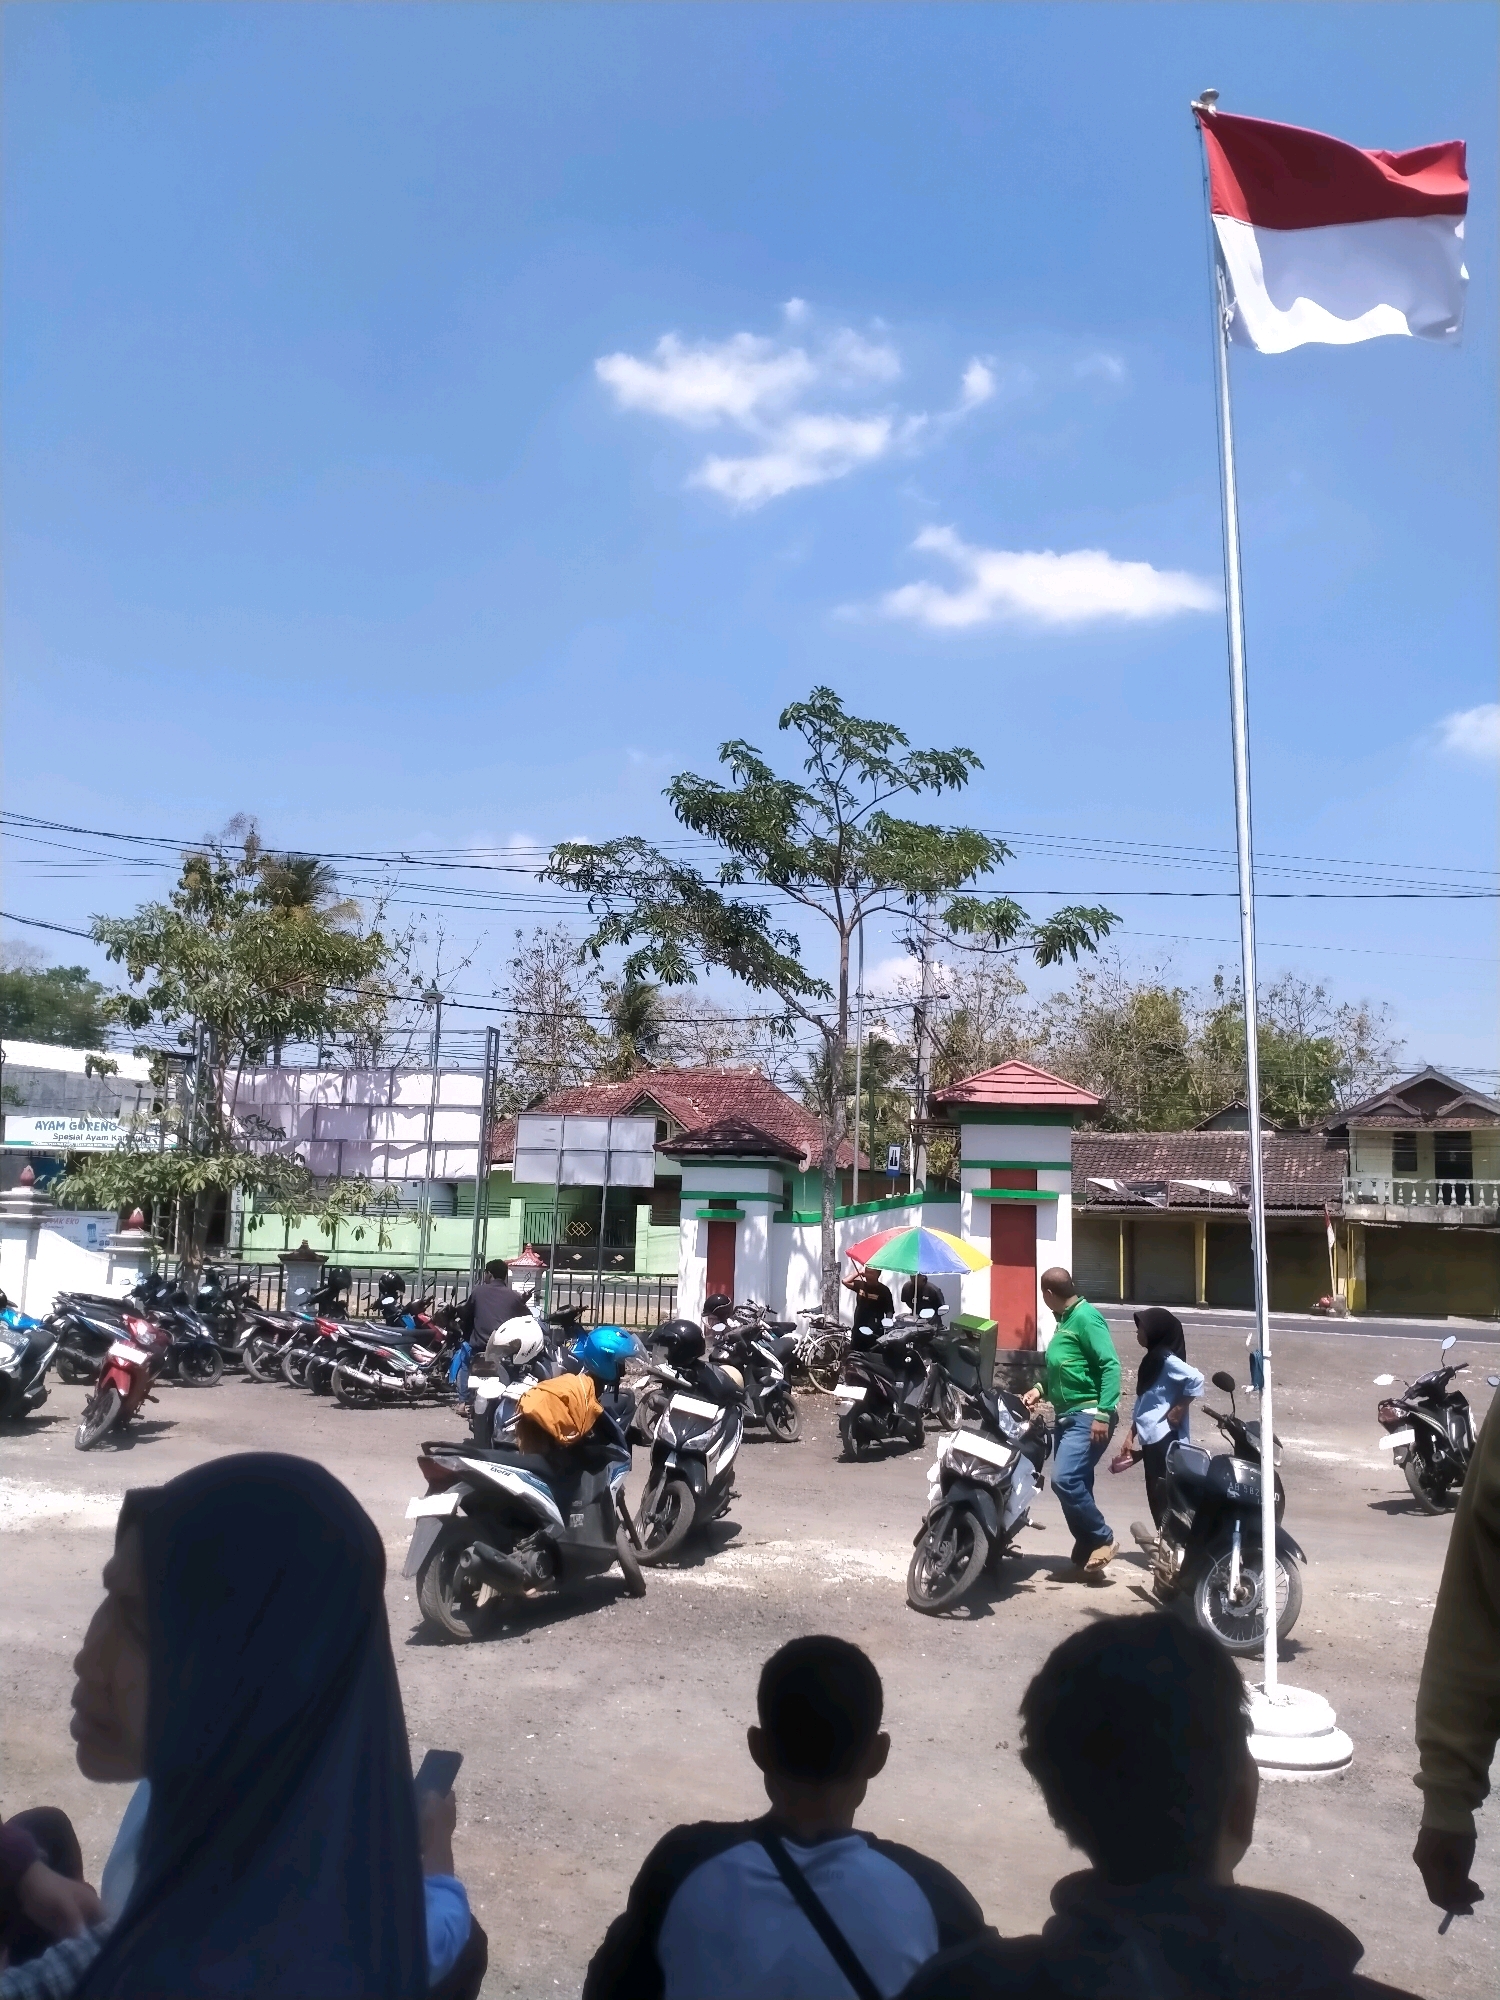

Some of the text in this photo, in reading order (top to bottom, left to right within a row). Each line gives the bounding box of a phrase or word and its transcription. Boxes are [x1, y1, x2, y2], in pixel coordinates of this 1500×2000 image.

[34, 1120, 118, 1132] AYAM GORENG
[53, 1132, 83, 1141] Spesial
[86, 1133, 109, 1142] Ayam
[1228, 1482, 1240, 1491] AB
[1243, 1485, 1260, 1497] 582
